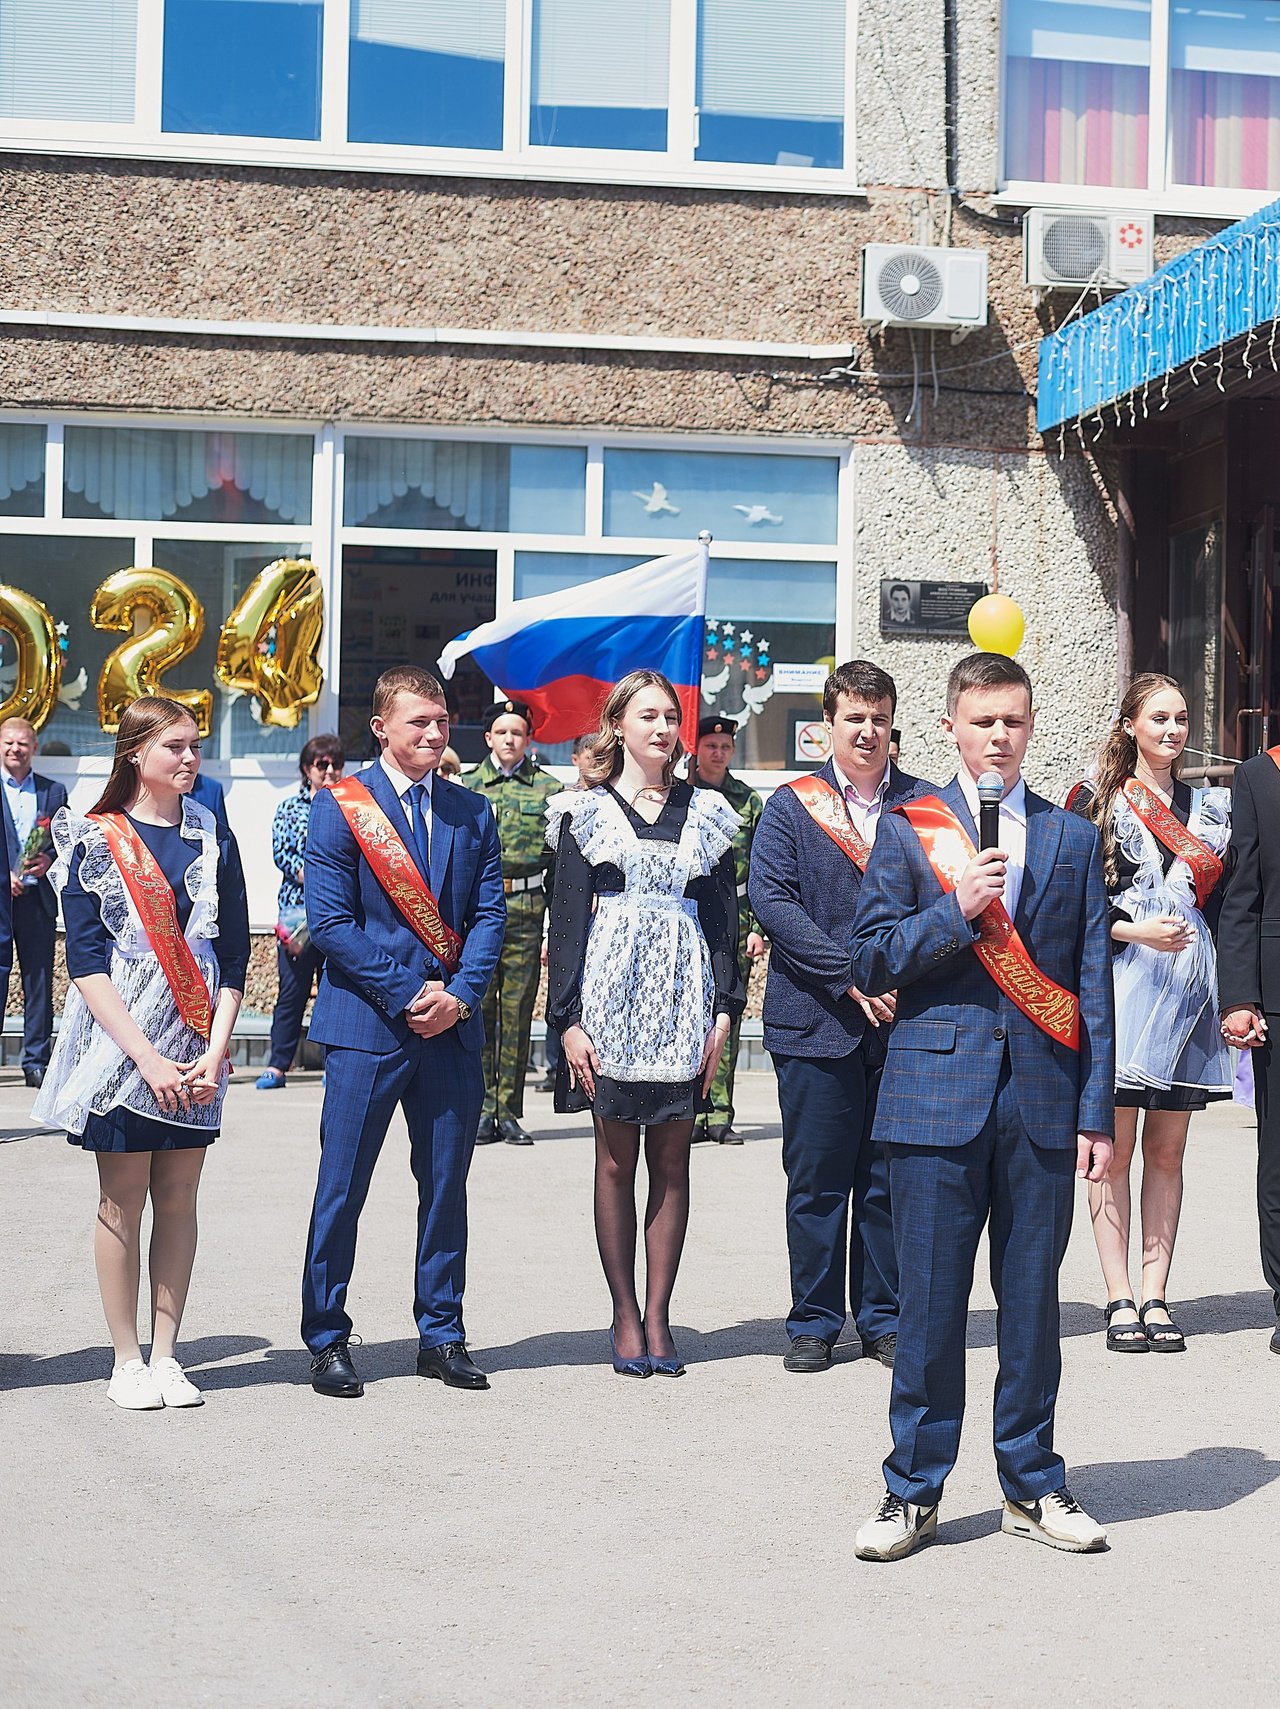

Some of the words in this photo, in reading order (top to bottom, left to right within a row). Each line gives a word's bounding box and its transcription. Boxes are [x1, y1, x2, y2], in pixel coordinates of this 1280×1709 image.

[430, 591, 457, 604] для
[134, 870, 195, 990] Выпускник
[1025, 989, 1077, 1039] 2024
